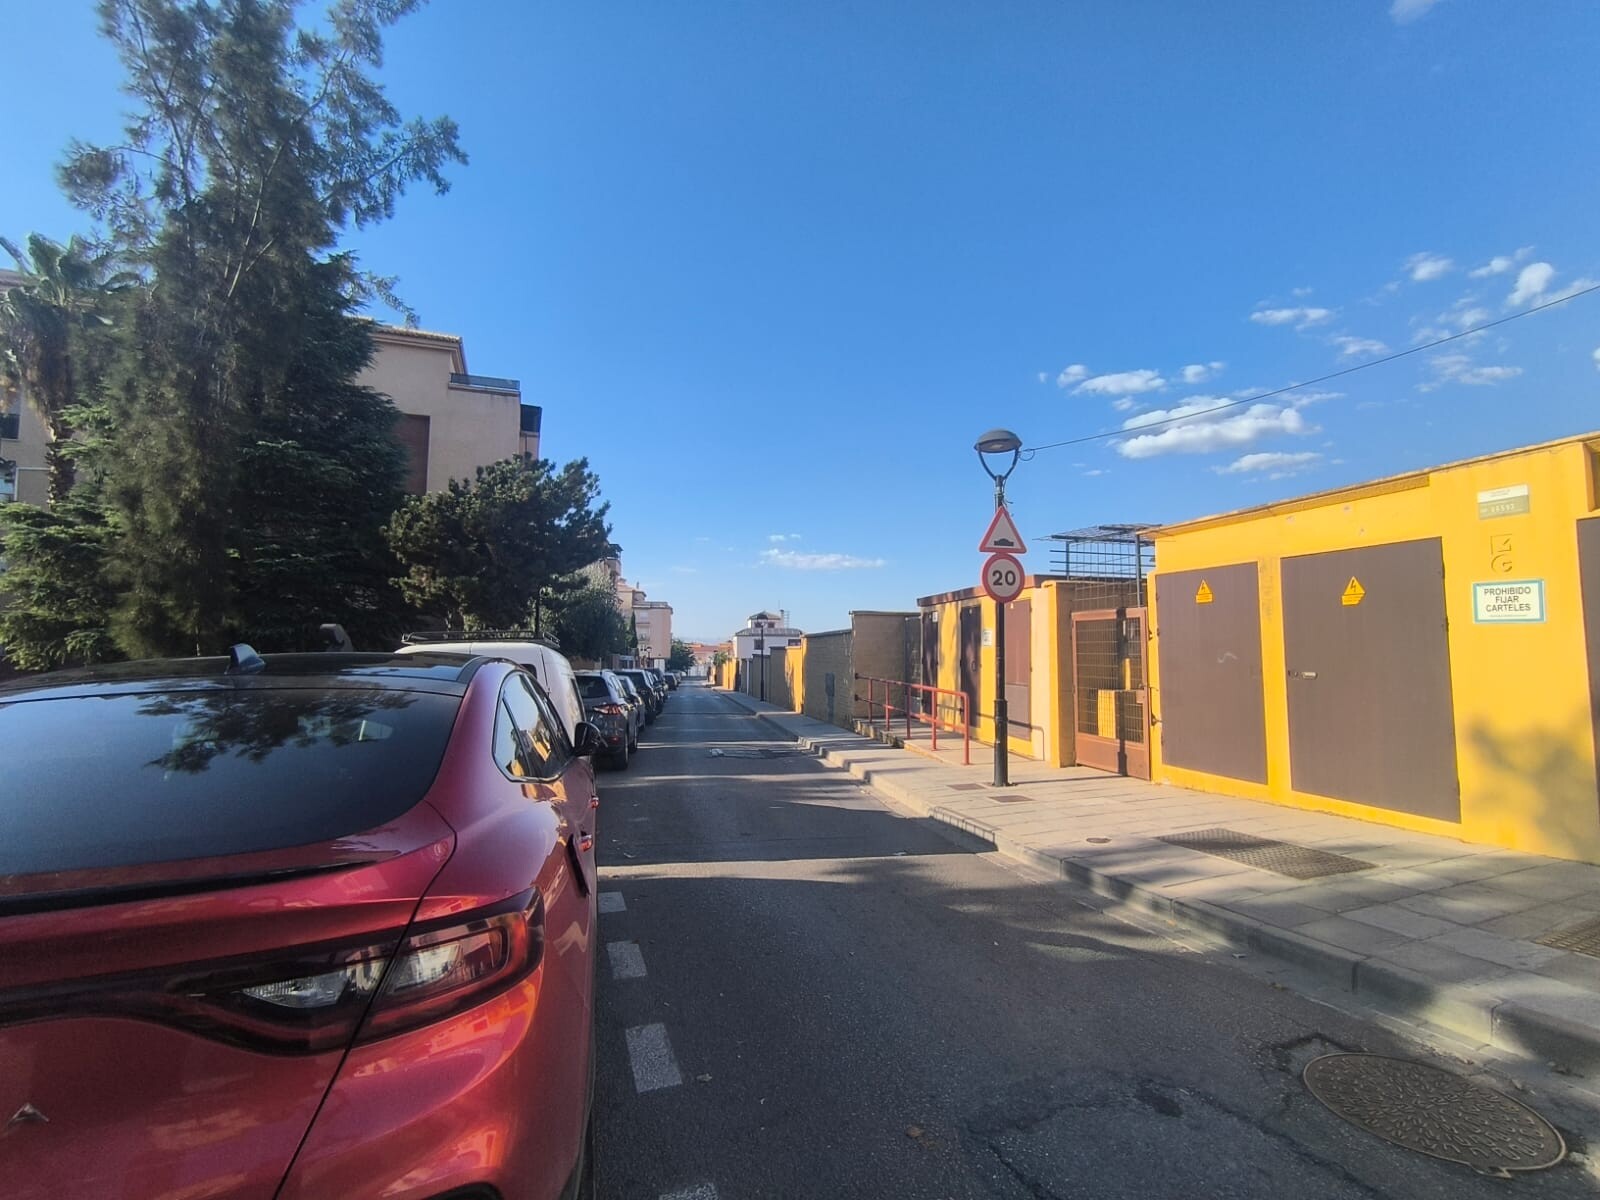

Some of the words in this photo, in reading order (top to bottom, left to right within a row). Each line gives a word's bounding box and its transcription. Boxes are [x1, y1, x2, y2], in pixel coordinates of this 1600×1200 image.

[992, 570, 1016, 586] 20
[1483, 586, 1532, 596] PROHIBIDO
[1495, 595, 1520, 604] FIJAR
[1485, 603, 1532, 612] CARTELES
